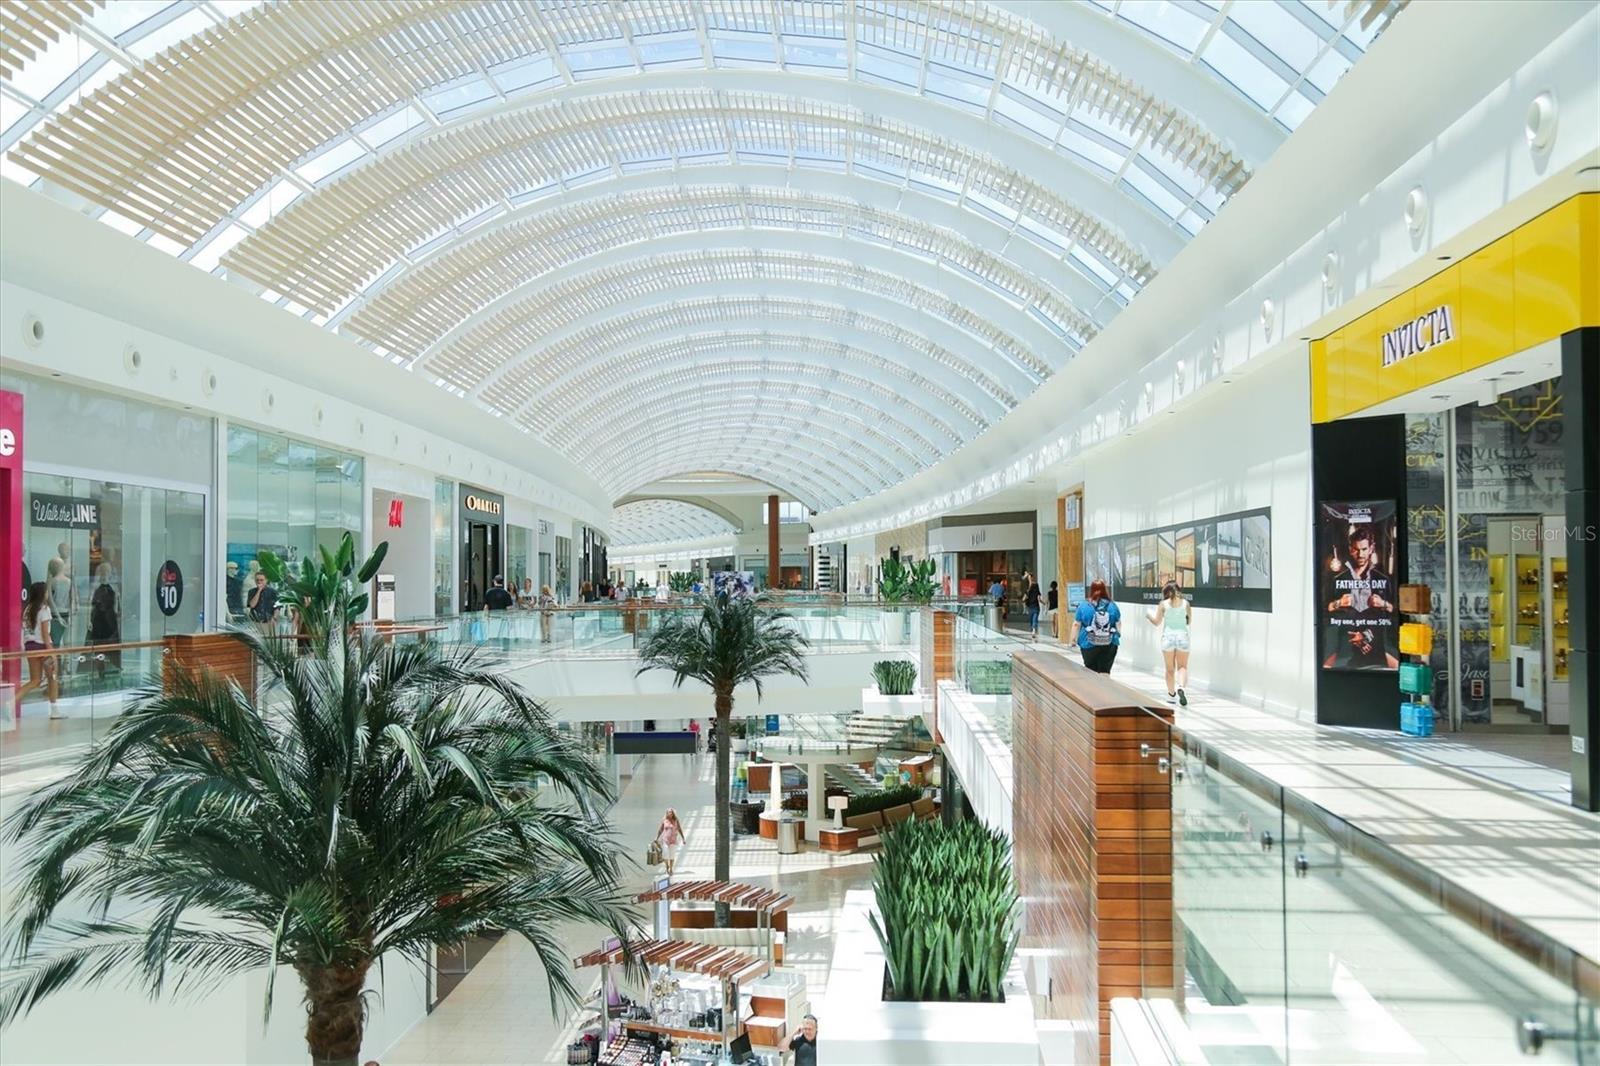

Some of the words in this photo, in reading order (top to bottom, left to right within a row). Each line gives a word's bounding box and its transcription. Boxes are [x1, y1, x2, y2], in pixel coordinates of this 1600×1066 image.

[1382, 306, 1453, 367] INVICTA
[33, 500, 59, 522] Walk
[59, 507, 72, 522] the
[70, 504, 97, 527] LINE
[1335, 579, 1370, 589] FATHER'S
[1371, 579, 1387, 589] DAY
[160, 586, 177, 609] $10
[1330, 617, 1342, 626] Buy
[1355, 618, 1366, 627] get
[1378, 618, 1392, 626] 50%
